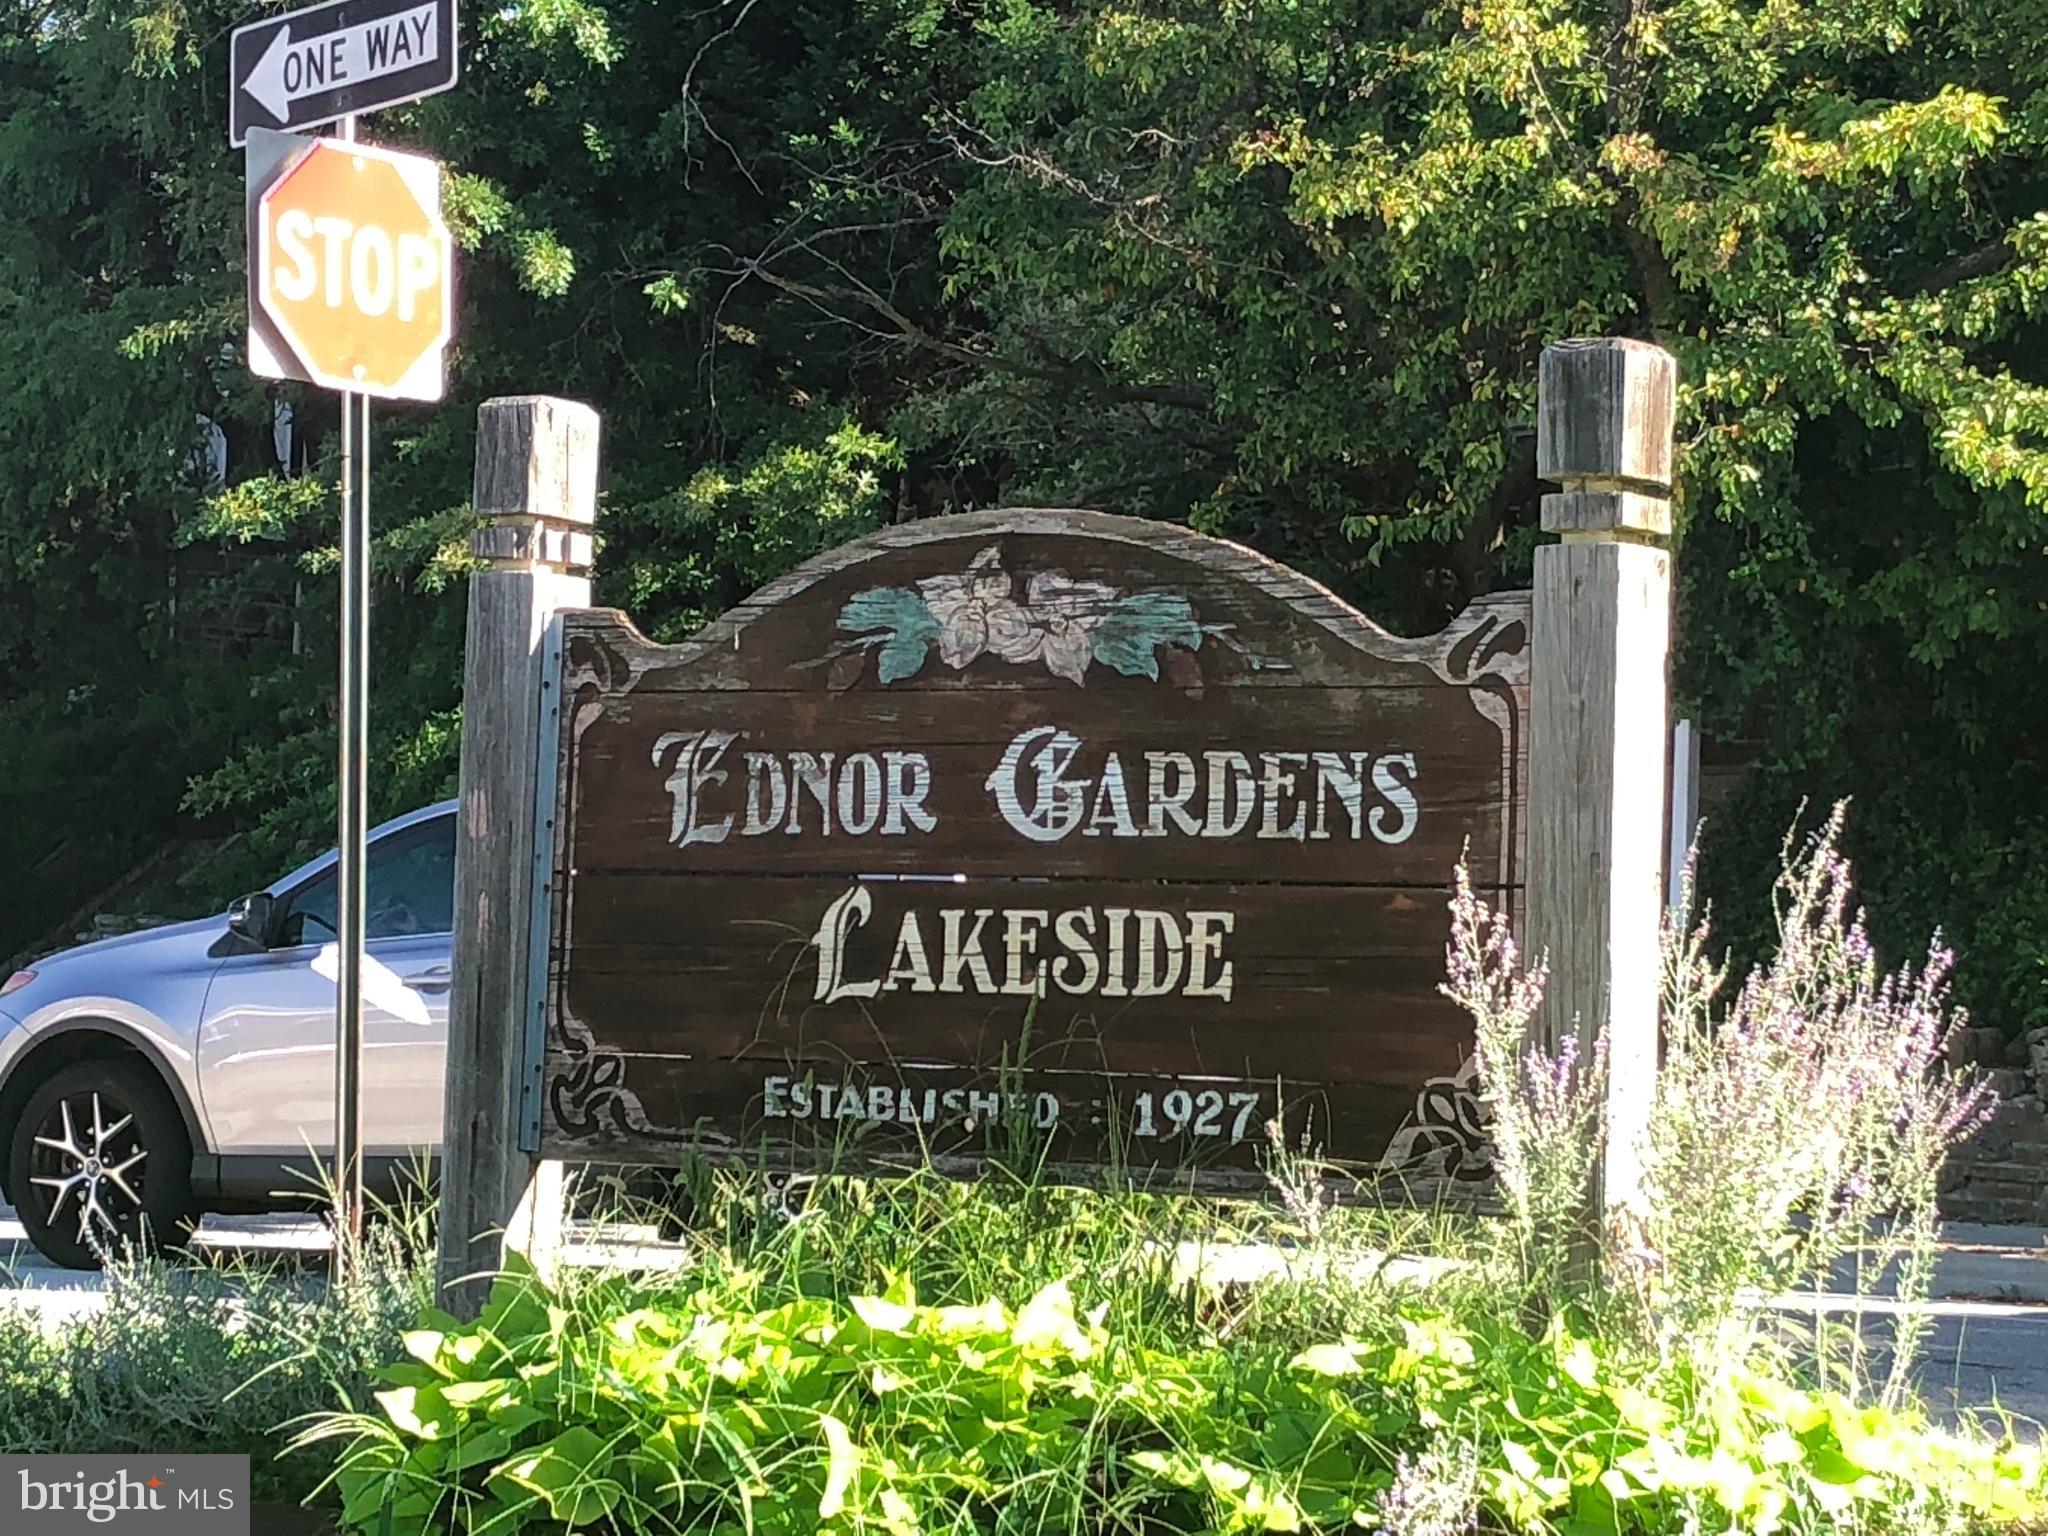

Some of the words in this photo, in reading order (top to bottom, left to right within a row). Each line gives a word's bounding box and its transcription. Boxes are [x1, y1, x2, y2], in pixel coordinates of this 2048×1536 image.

[283, 37, 347, 94] ONE
[366, 11, 433, 71] WAY
[274, 208, 440, 323] STOP
[652, 730, 938, 849] EDNOR
[984, 725, 1419, 844] GARDENS
[811, 884, 1235, 1004] LAKESIDE
[1134, 1089, 1260, 1147] 1927
